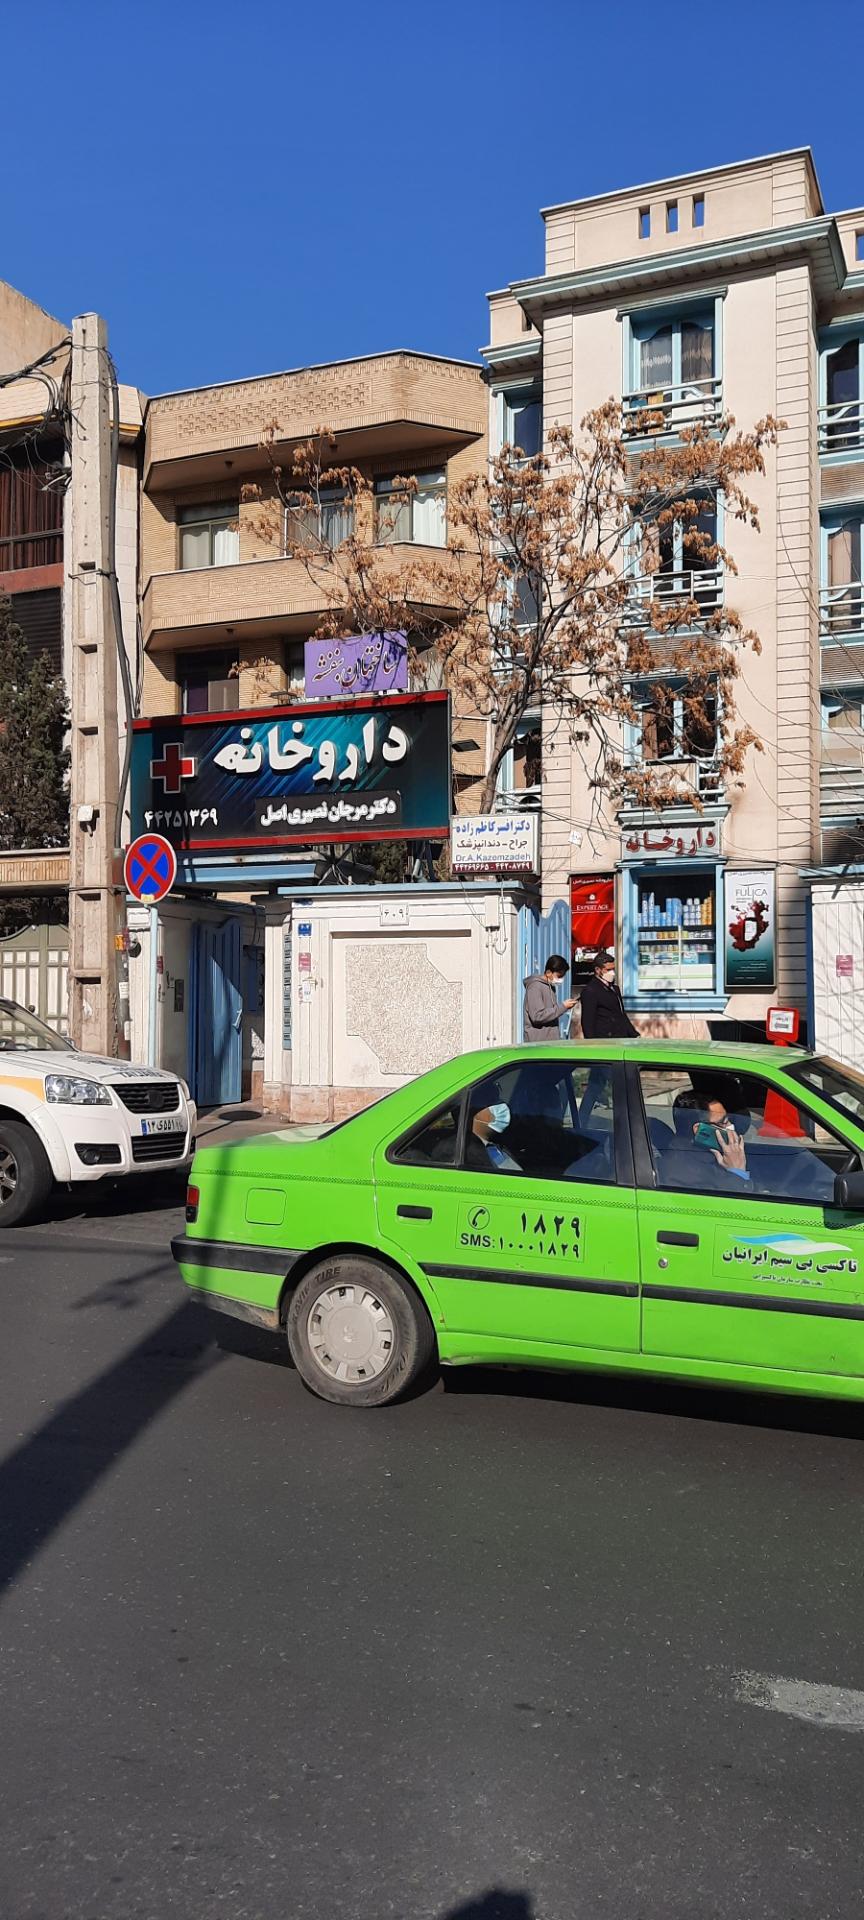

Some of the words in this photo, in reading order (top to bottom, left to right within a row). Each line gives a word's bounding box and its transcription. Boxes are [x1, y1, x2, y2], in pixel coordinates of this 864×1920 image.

[312, 647, 345, 683] بنفشه
[341, 641, 398, 690] ساختمان
[213, 716, 410, 782] داروخانه
[144, 807, 218, 829] ۴۴۲۵۱۳۶۹
[260, 803, 288, 827] اصل
[287, 800, 328, 825] نصیری
[328, 799, 369, 823] مرجان
[365, 796, 397, 821] دکتر
[456, 821, 474, 836] زاده
[475, 820, 496, 836] کاظم
[496, 818, 513, 836] افسر
[513, 819, 531, 835] دکتر
[456, 839, 501, 851] دندانپزشک
[509, 839, 528, 850] جراح
[625, 827, 716, 856] داروخانه
[521, 1212, 580, 1239] ۱۸۲۹
[460, 1232, 495, 1248] SMS:
[499, 1237, 579, 1258] ۱۰۰۰۱۸۲۹
[722, 1246, 768, 1265] ایرانیان
[770, 1257, 792, 1268] سیم
[796, 1258, 813, 1271] بی
[314, 1266, 341, 1282] TIRE
[816, 1259, 857, 1274] تاکسی
